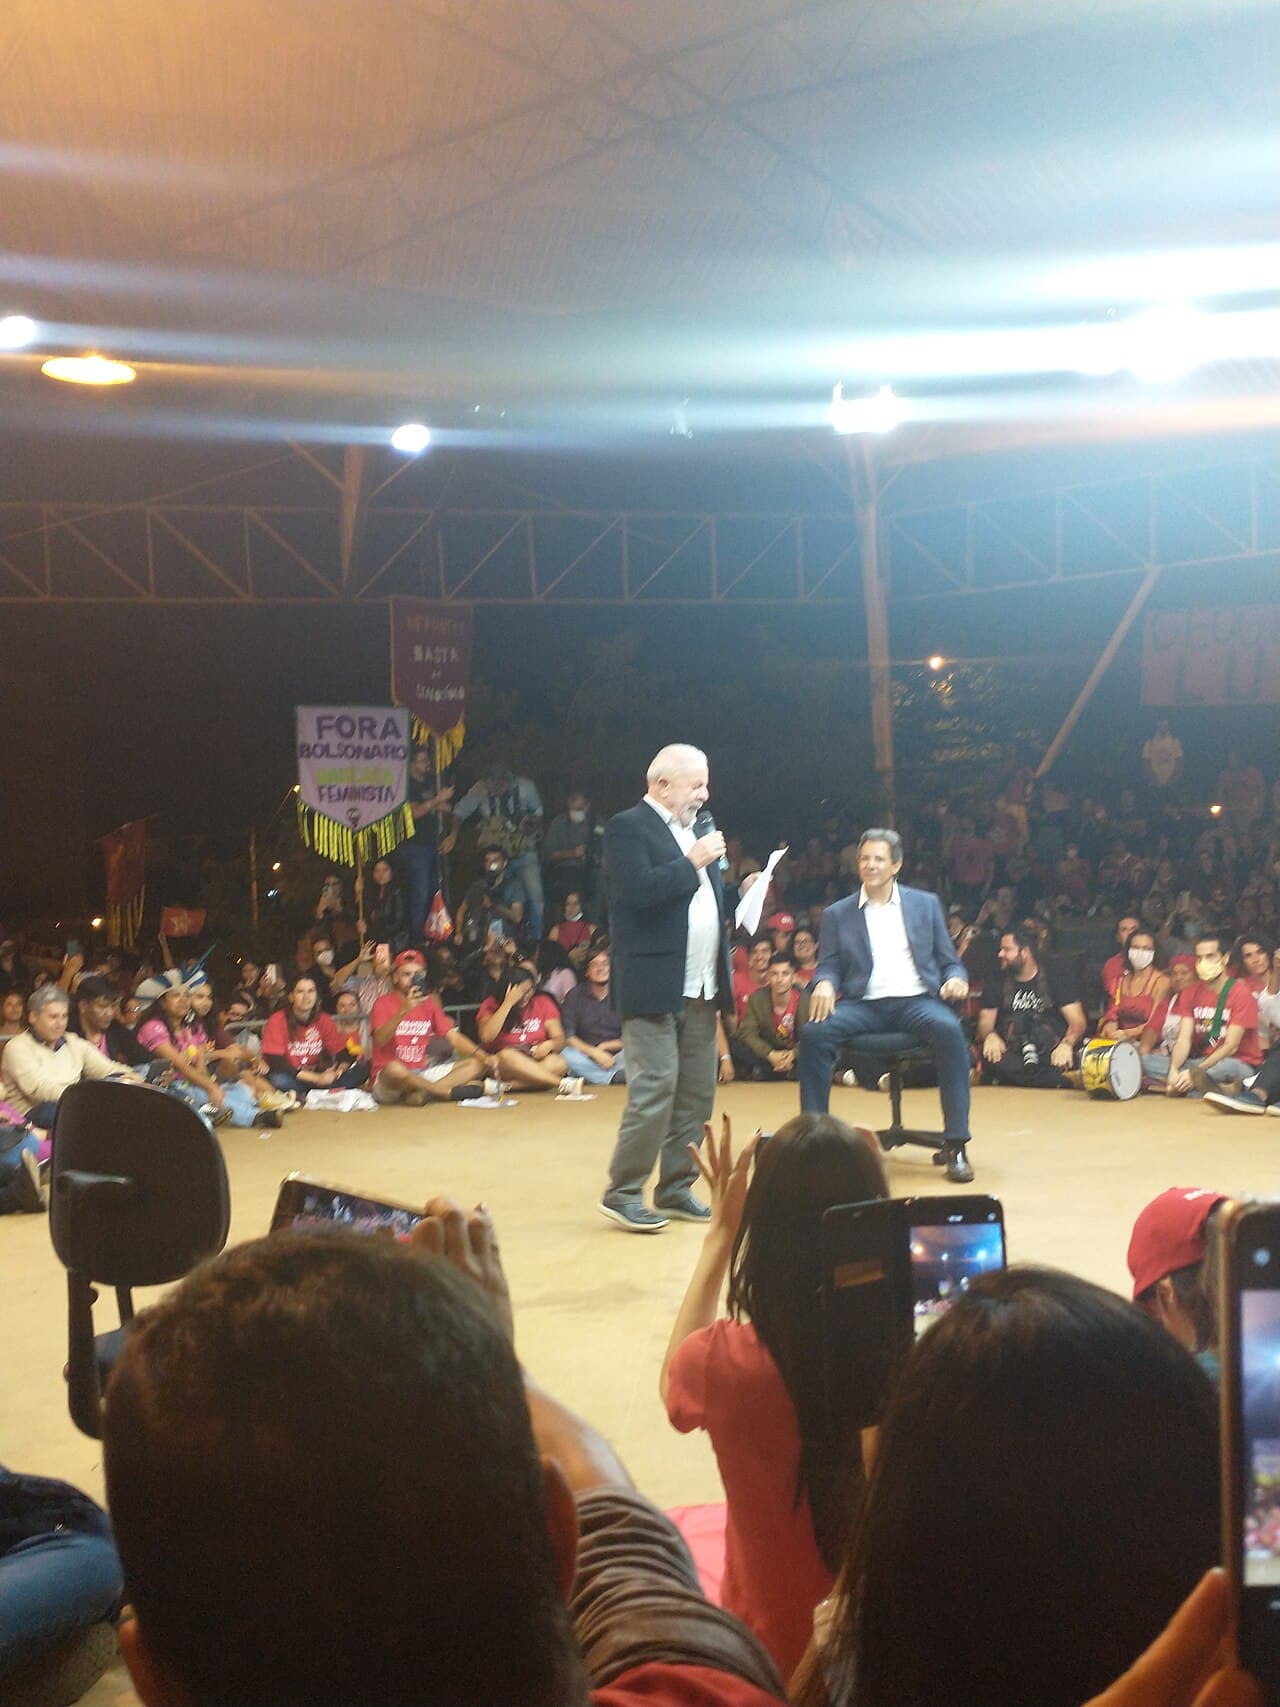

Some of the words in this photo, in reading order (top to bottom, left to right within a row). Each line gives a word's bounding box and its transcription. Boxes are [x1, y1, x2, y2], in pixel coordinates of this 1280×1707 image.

[316, 714, 402, 740] FORA
[299, 741, 408, 760] BOLSONARO
[318, 785, 396, 804] FEMINISTA
